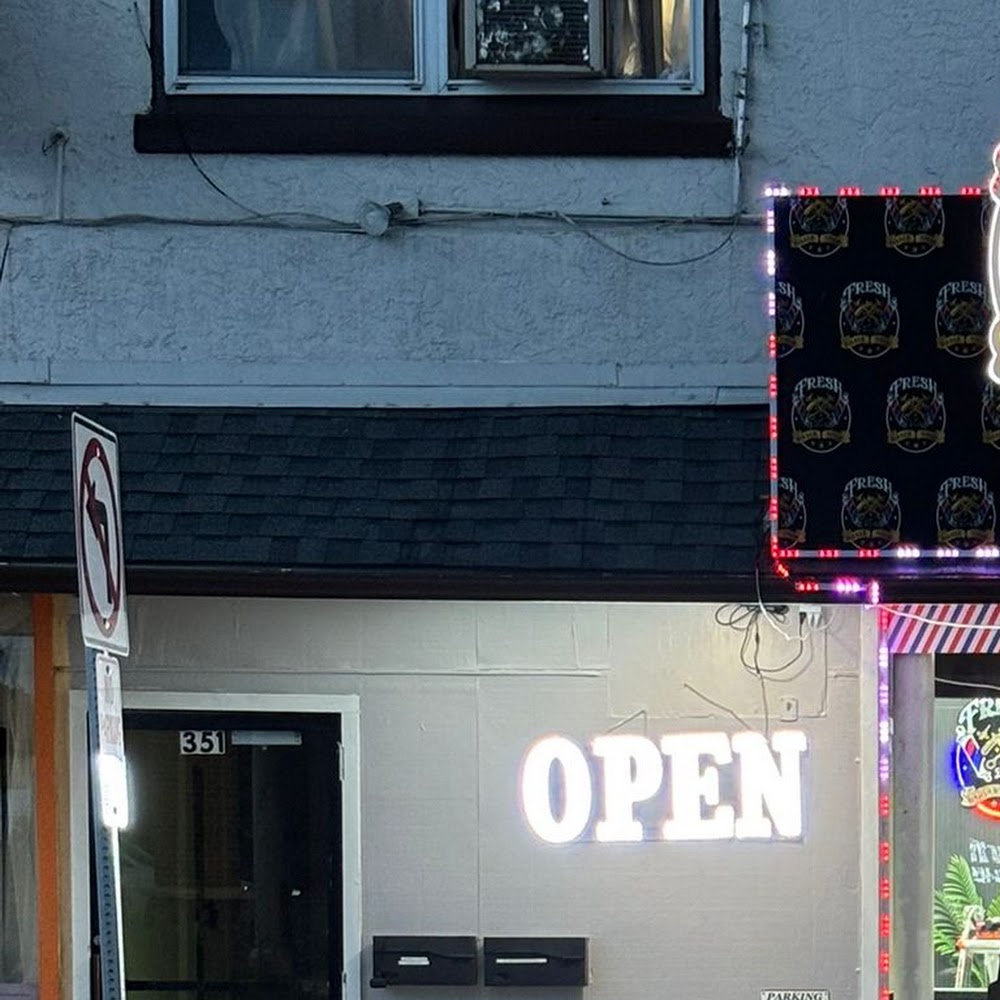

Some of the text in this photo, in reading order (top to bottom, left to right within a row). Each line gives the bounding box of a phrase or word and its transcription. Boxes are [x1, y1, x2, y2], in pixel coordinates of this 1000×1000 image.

[182, 730, 225, 752] 351
[521, 731, 808, 844] OPEN
[767, 992, 822, 1000] PARKING
